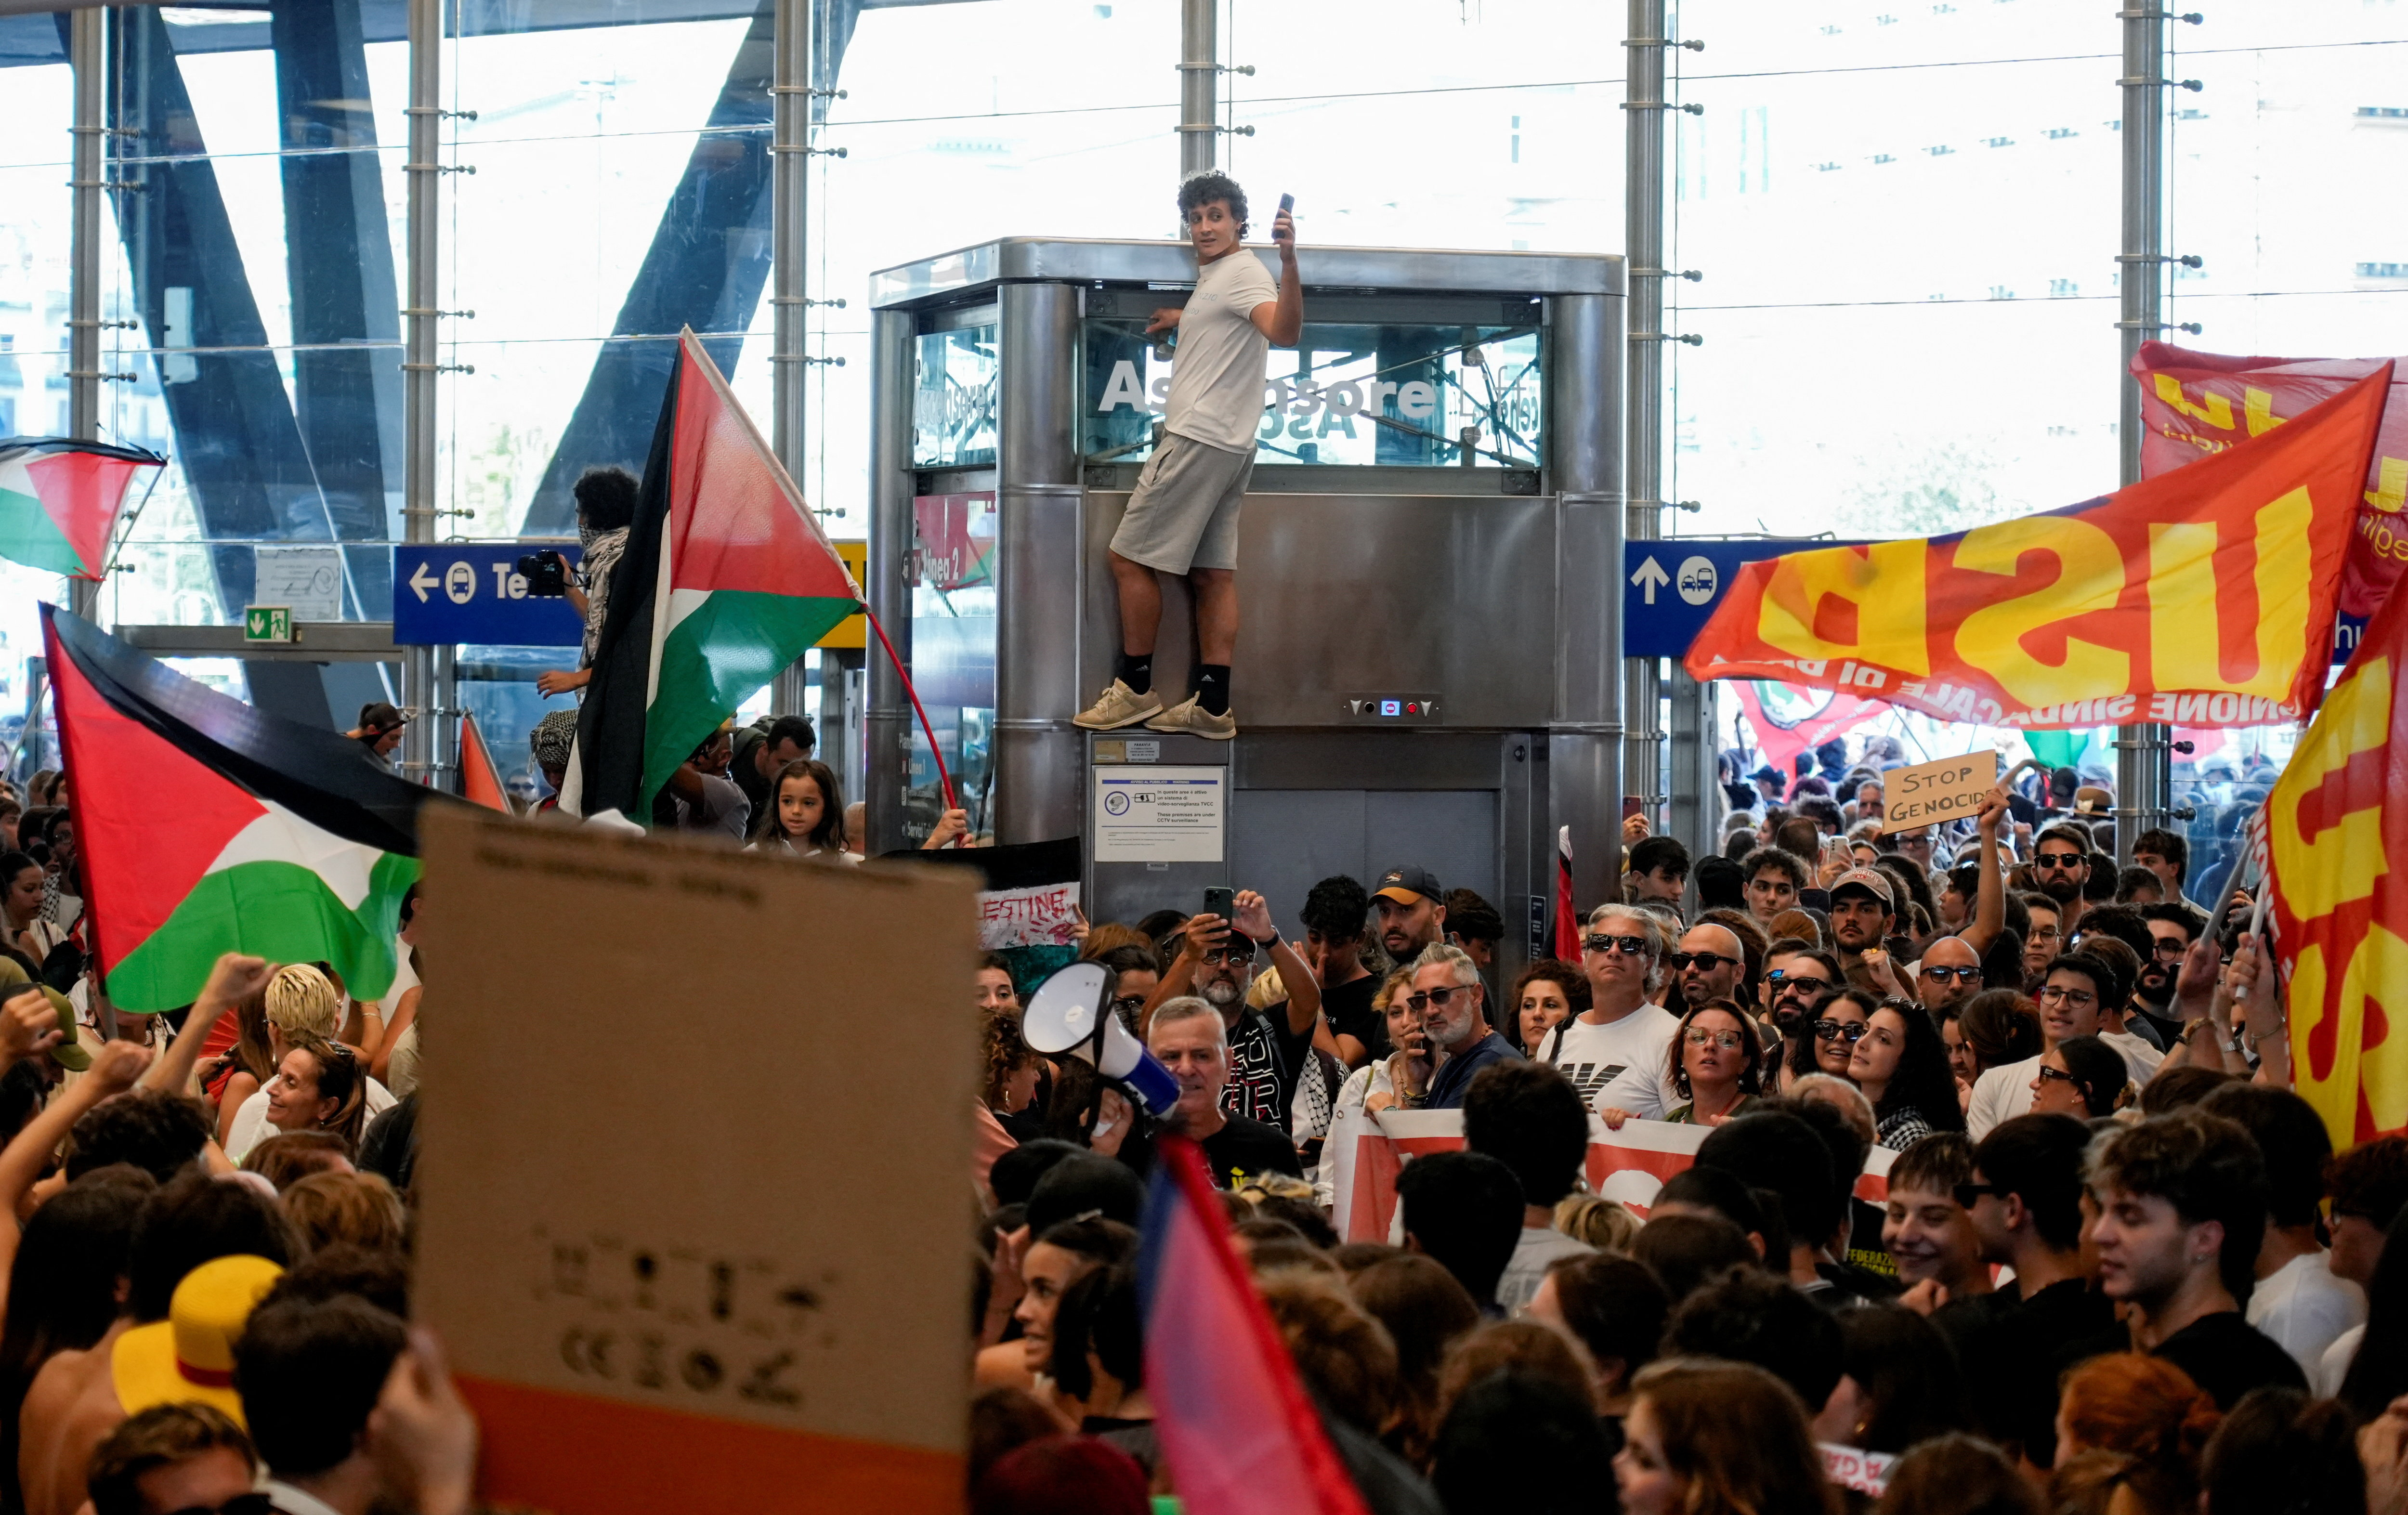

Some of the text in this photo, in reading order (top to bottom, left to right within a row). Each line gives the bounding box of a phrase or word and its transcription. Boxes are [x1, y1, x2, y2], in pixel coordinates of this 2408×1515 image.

[1098, 360, 1437, 418] Asnsore
[1902, 767, 1972, 793] STOP
[979, 888, 1066, 921] ESTINE
